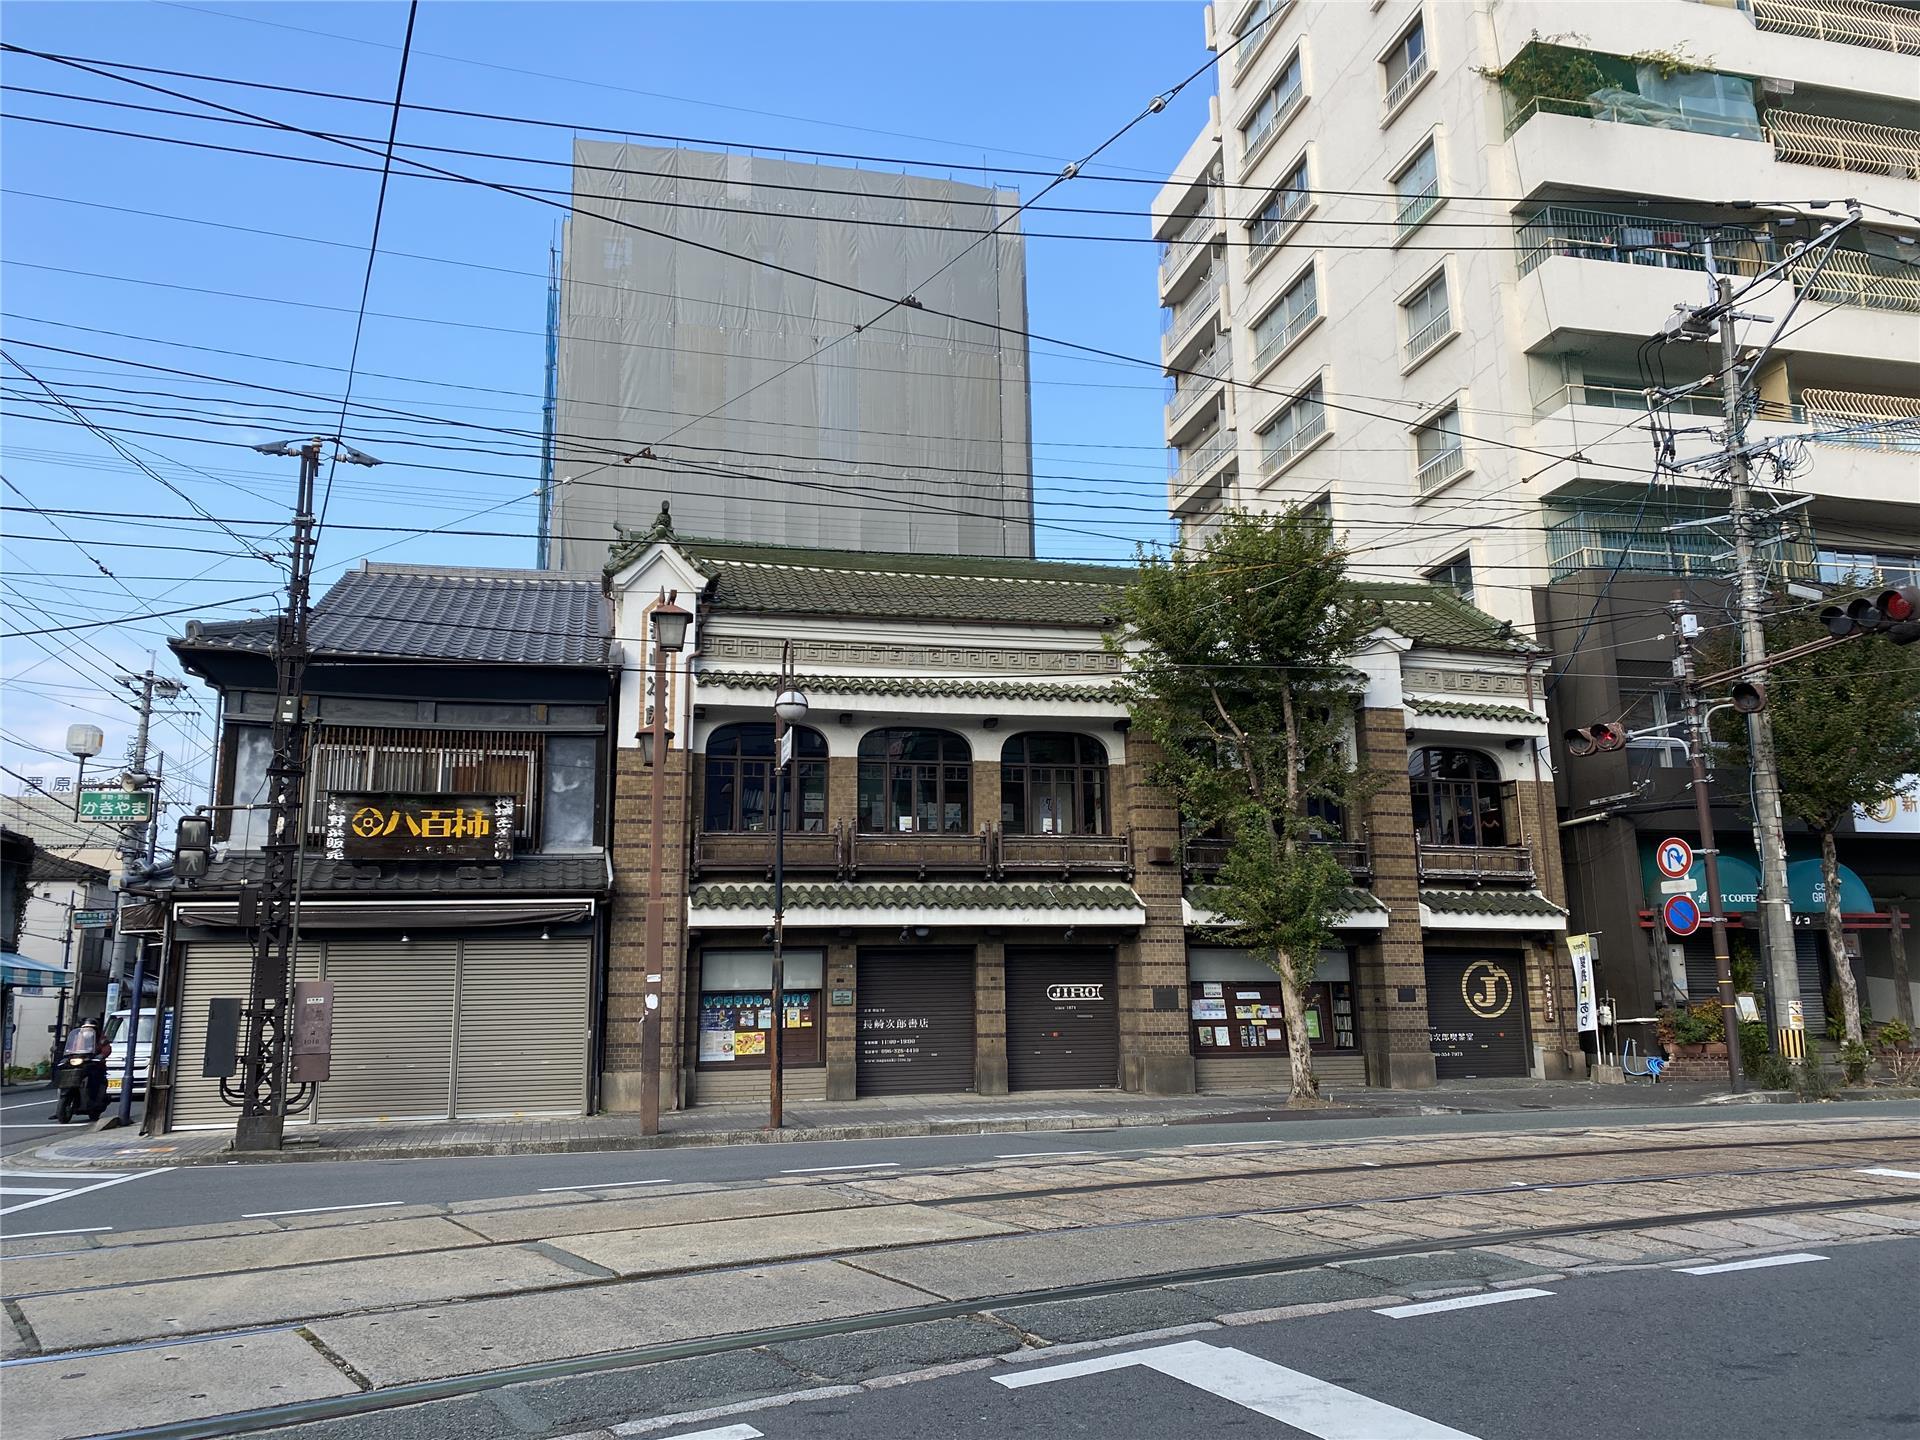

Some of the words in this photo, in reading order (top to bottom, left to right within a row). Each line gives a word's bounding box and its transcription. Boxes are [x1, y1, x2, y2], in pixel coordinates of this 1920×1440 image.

[82, 801, 146, 814] かきやま
[382, 807, 490, 839] 八百柿
[1052, 986, 1096, 998] JIRO
[1474, 976, 1499, 1007] J
